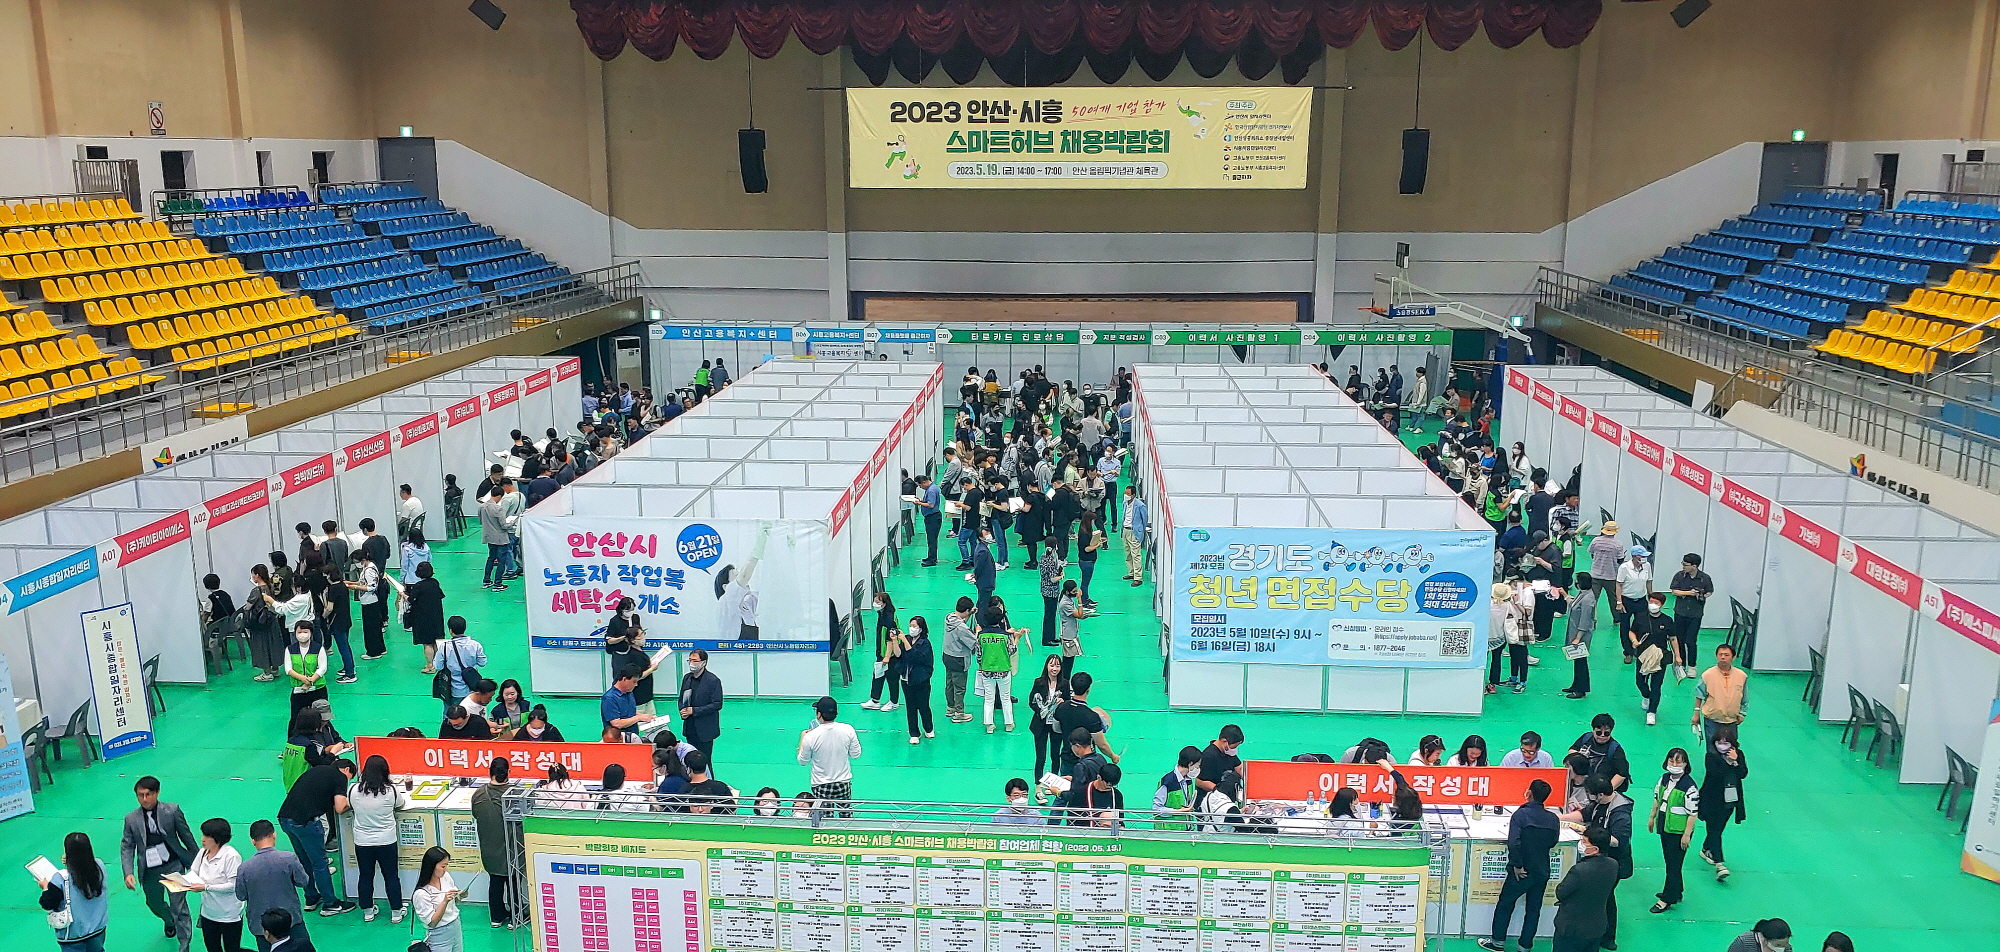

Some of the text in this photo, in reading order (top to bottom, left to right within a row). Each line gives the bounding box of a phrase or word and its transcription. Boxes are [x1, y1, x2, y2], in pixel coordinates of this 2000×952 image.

[890, 99, 1063, 124] 2023 안산·시흥
[1071, 99, 1167, 118] 50여개 기업 참가
[946, 129, 1171, 154] 스마트허브 채용박람회
[1017, 166, 1035, 175] 14:00
[1044, 166, 1063, 175] 17:00
[1072, 166, 1087, 175] 안산
[1135, 166, 1159, 176] 체육관
[681, 328, 778, 340] 안산고용복지+센터
[971, 332, 1065, 342] 타로카드 진로상담
[1188, 333, 1218, 342] 이력서
[1273, 334, 1279, 342] 1
[1337, 333, 1368, 343] 이력서
[1424, 333, 1432, 343] 2
[335, 455, 346, 467] A04
[270, 481, 283, 493] A03
[193, 510, 207, 526] A02
[567, 531, 658, 559] 안산시
[677, 534, 721, 555] 6월 21일
[101, 548, 117, 564] A01
[686, 547, 719, 563] OPEN
[1199, 553, 1225, 563] 2023년
[1227, 543, 1314, 573] 경기도
[1189, 562, 1226, 571] 제1차 모집
[19, 558, 91, 598] 시흥시종합일자리센터
[543, 564, 686, 591] 노동자 작업복
[1187, 573, 1413, 613] 청년 면접수당
[1436, 592, 1458, 601] 5만원
[637, 593, 682, 616] 개소
[1422, 600, 1469, 610] 최대 50만원!
[1924, 594, 1939, 610] A51
[1192, 615, 1225, 625] 모집일시
[1190, 626, 1227, 639] 2023년
[1229, 627, 1247, 640] 5월
[1248, 627, 1291, 640] 10일(수)
[1293, 628, 1312, 641] 9시
[1190, 640, 1277, 653] 6월 16일(금) 18시
[102, 620, 127, 729] 시흥시종합일자리센터
[424, 748, 583, 772] 이력서 작성대
[1318, 772, 1491, 797] 이력서 작성대
[812, 833, 846, 845] 2023
[894, 835, 945, 848] 스마트허브
[946, 836, 998, 850] 채용박람회
[999, 838, 1041, 851] 참여업체
